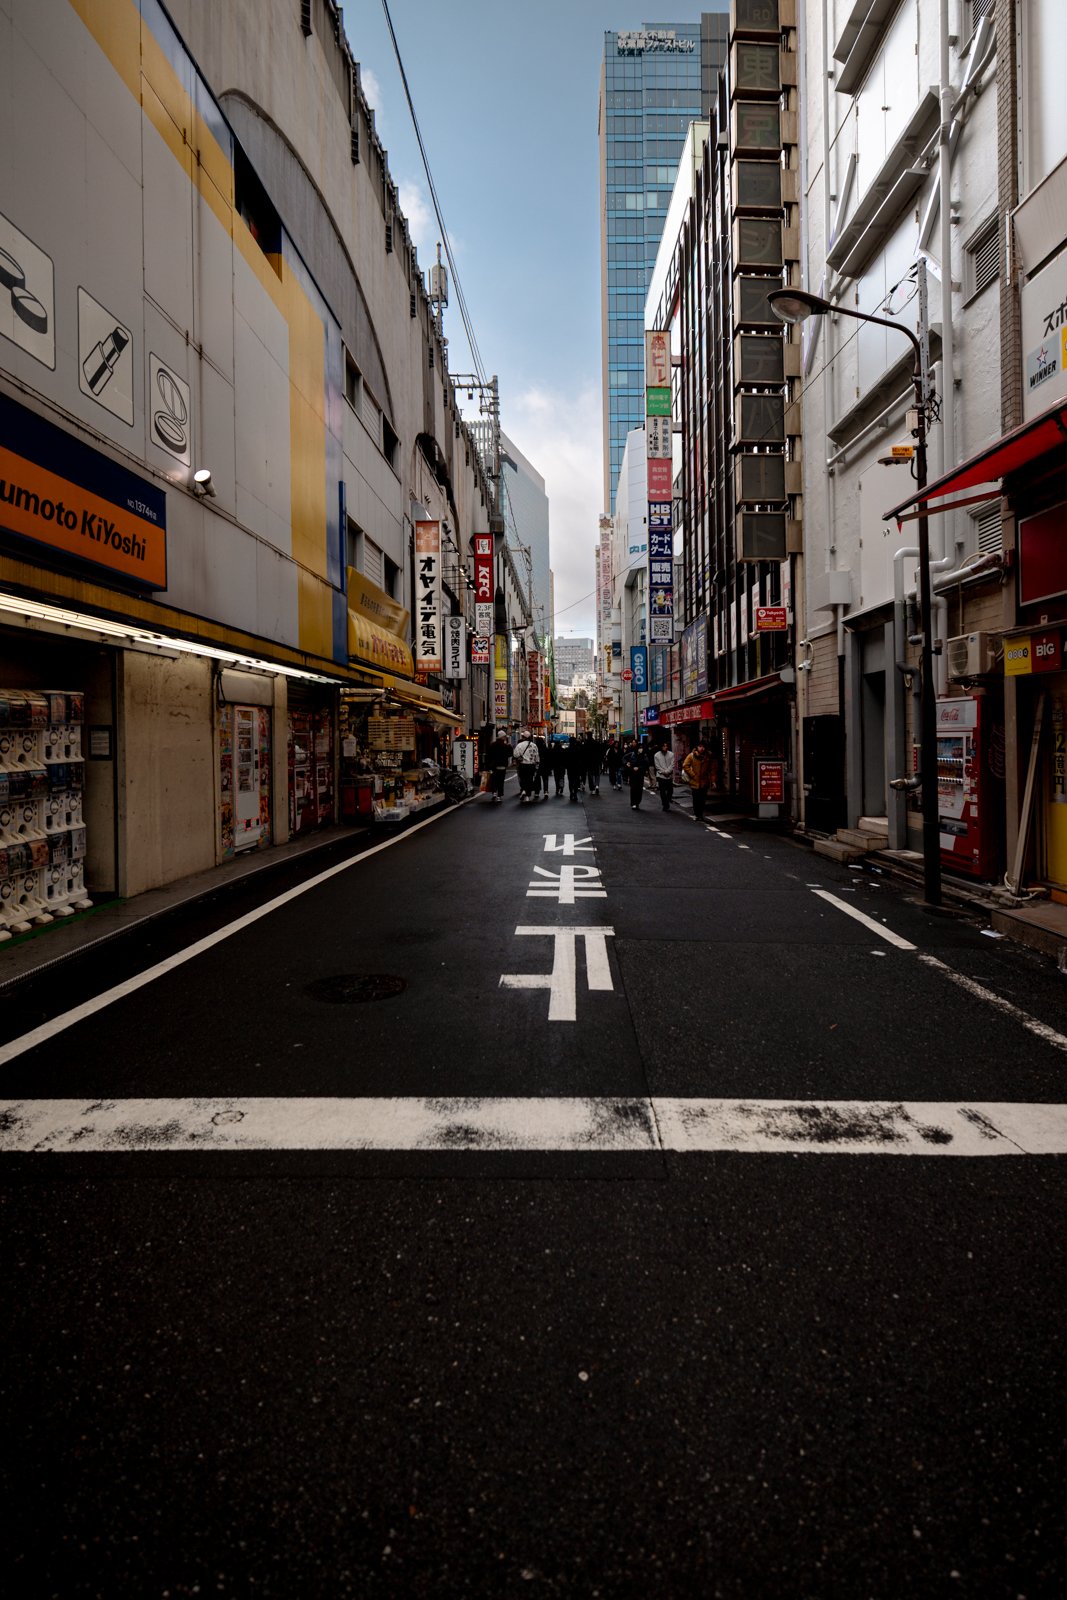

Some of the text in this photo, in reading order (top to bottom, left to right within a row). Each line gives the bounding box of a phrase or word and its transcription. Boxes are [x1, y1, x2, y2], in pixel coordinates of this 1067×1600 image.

[617, 39, 696, 49] 秋葉原ファーストビル
[1029, 360, 1057, 388] WINNER
[650, 504, 671, 513] HB
[650, 516, 671, 525] ST
[80, 510, 147, 561] KiYoshi
[650, 534, 671, 544] カード
[650, 545, 671, 555] ゲーム
[651, 562, 671, 572] 販売
[478, 565, 490, 597] KFC
[651, 573, 671, 583] 買取
[419, 556, 437, 656] オヤイデ電気
[1035, 638, 1055, 657] BIG
[634, 653, 644, 685] GiGO
[498, 834, 616, 1021] 止まれ
